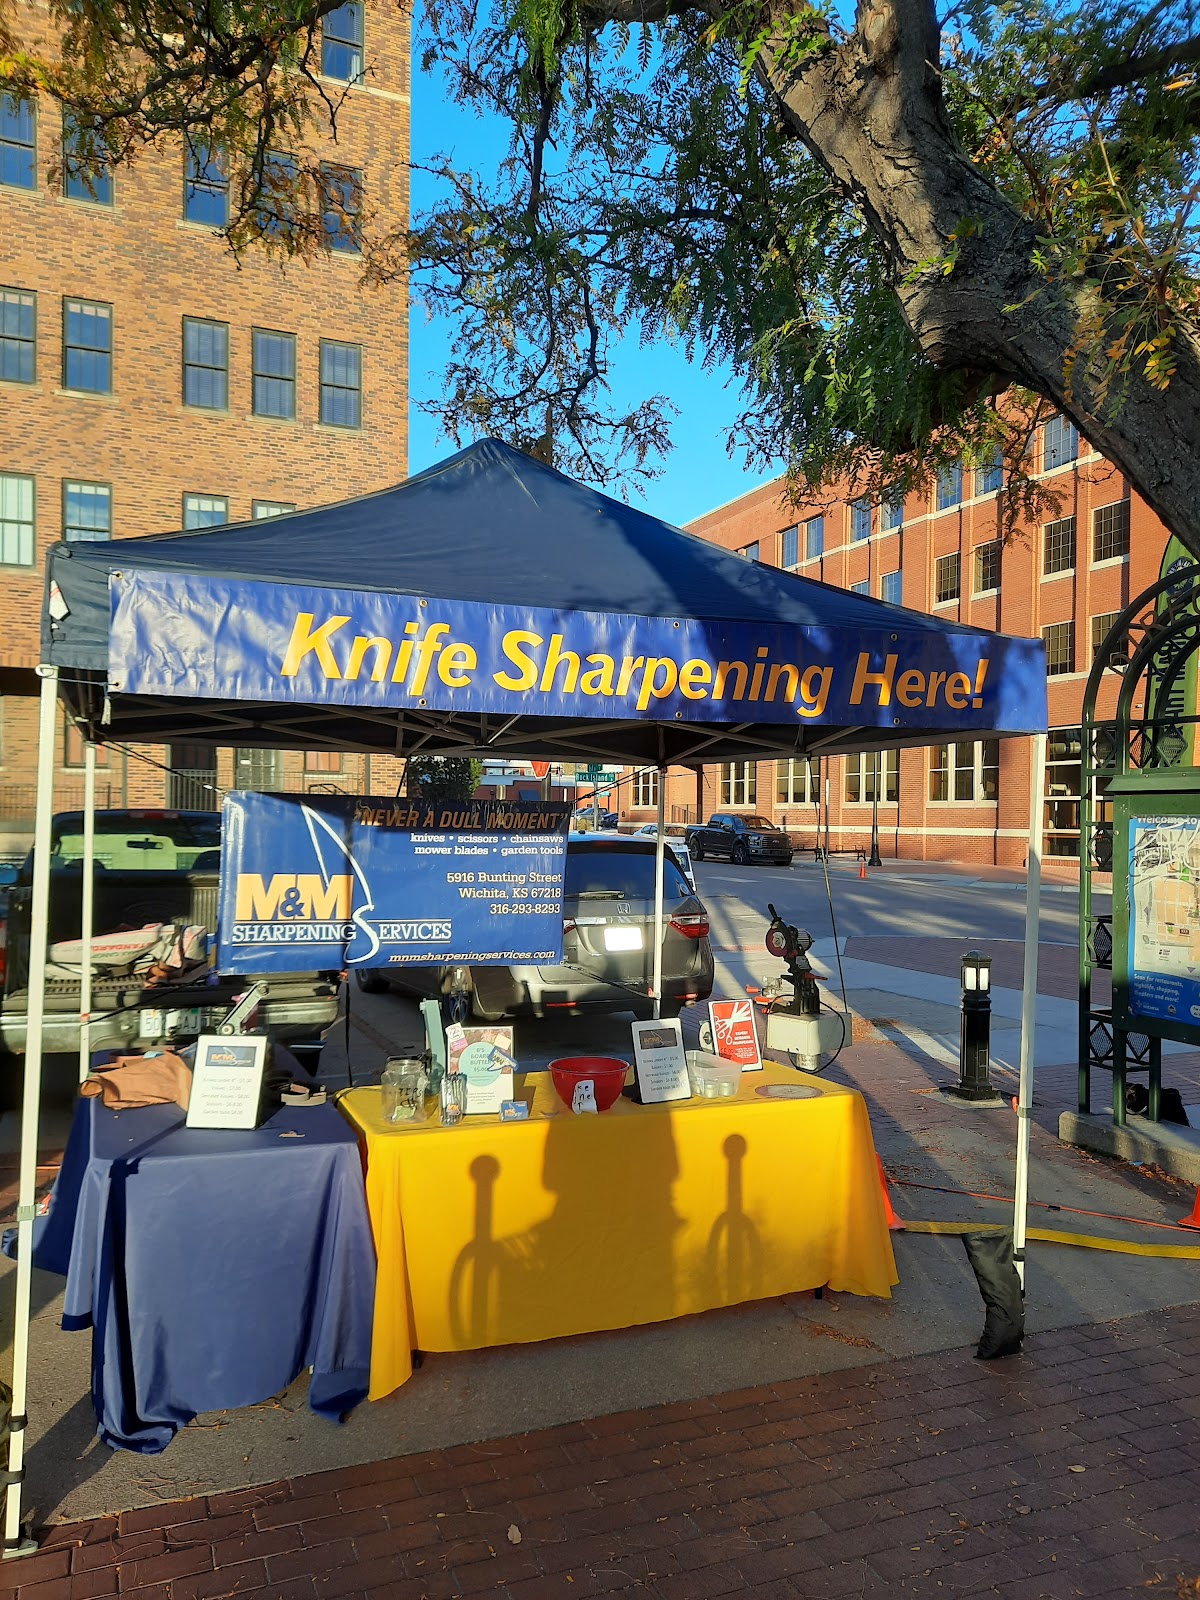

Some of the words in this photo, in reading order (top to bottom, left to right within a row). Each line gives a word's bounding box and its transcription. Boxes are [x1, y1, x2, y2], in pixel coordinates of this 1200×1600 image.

[280, 611, 478, 696] Knife
[492, 629, 834, 718] Sharpening
[849, 652, 989, 710] Here!
[590, 773, 608, 782] Island
[423, 810, 435, 828] A
[439, 811, 483, 829] DULL
[410, 832, 446, 843] knives
[457, 833, 499, 844] scissors
[510, 833, 564, 844] chainsaws
[414, 846, 452, 855] mower
[454, 845, 489, 855] blades
[501, 845, 539, 857] garden
[540, 845, 564, 855] tools
[447, 872, 475, 883] 5916
[477, 872, 526, 885] Bunting
[528, 872, 562, 883] Street
[234, 873, 355, 921] M&M
[458, 887, 510, 900] Wichita,
[512, 887, 528, 899] KS
[531, 887, 562, 899] 67218
[489, 903, 561, 914] 316-293-8293
[231, 923, 357, 942] SHARPENING
[388, 950, 555, 963] mnmsharpeningservices.com
[1134, 973, 1146, 981] Scan
[1146, 975, 1154, 983] for
